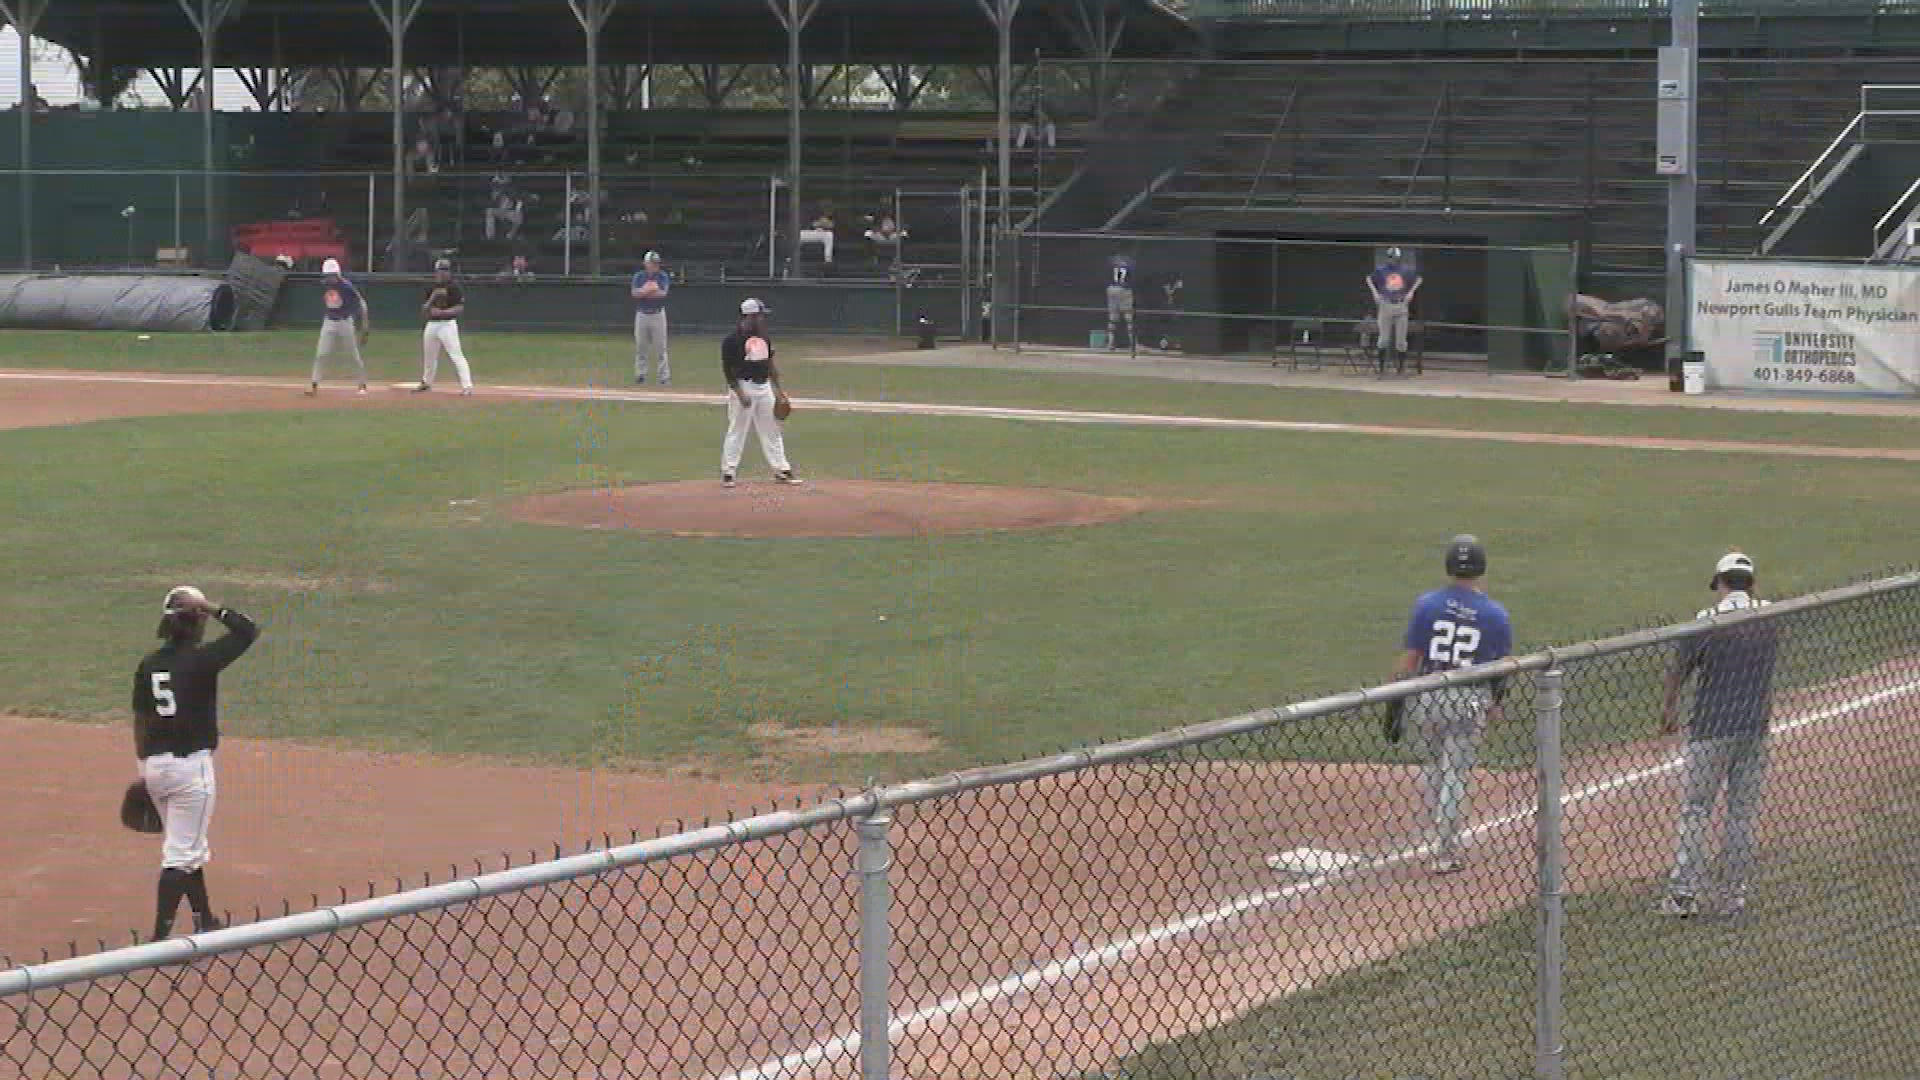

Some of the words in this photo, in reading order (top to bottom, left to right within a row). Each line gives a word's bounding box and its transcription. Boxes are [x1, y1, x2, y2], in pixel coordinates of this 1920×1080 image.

[1113, 267, 1128, 284] 17
[1725, 279, 1770, 294] James
[1774, 279, 1785, 294] O
[1788, 280, 1835, 297] Maher
[1862, 285, 1888, 299] MD
[1697, 301, 1761, 318] Newport
[1764, 302, 1801, 317] Gulls
[1803, 303, 1842, 319] Team
[1846, 305, 1919, 325] Physician
[1784, 332, 1855, 350] UNIVERSITY
[1784, 350, 1856, 366] ORTHOPEDICS
[1753, 367, 1856, 384] 401-849-6868
[1429, 620, 1481, 667] 22
[151, 672, 177, 717] 5
